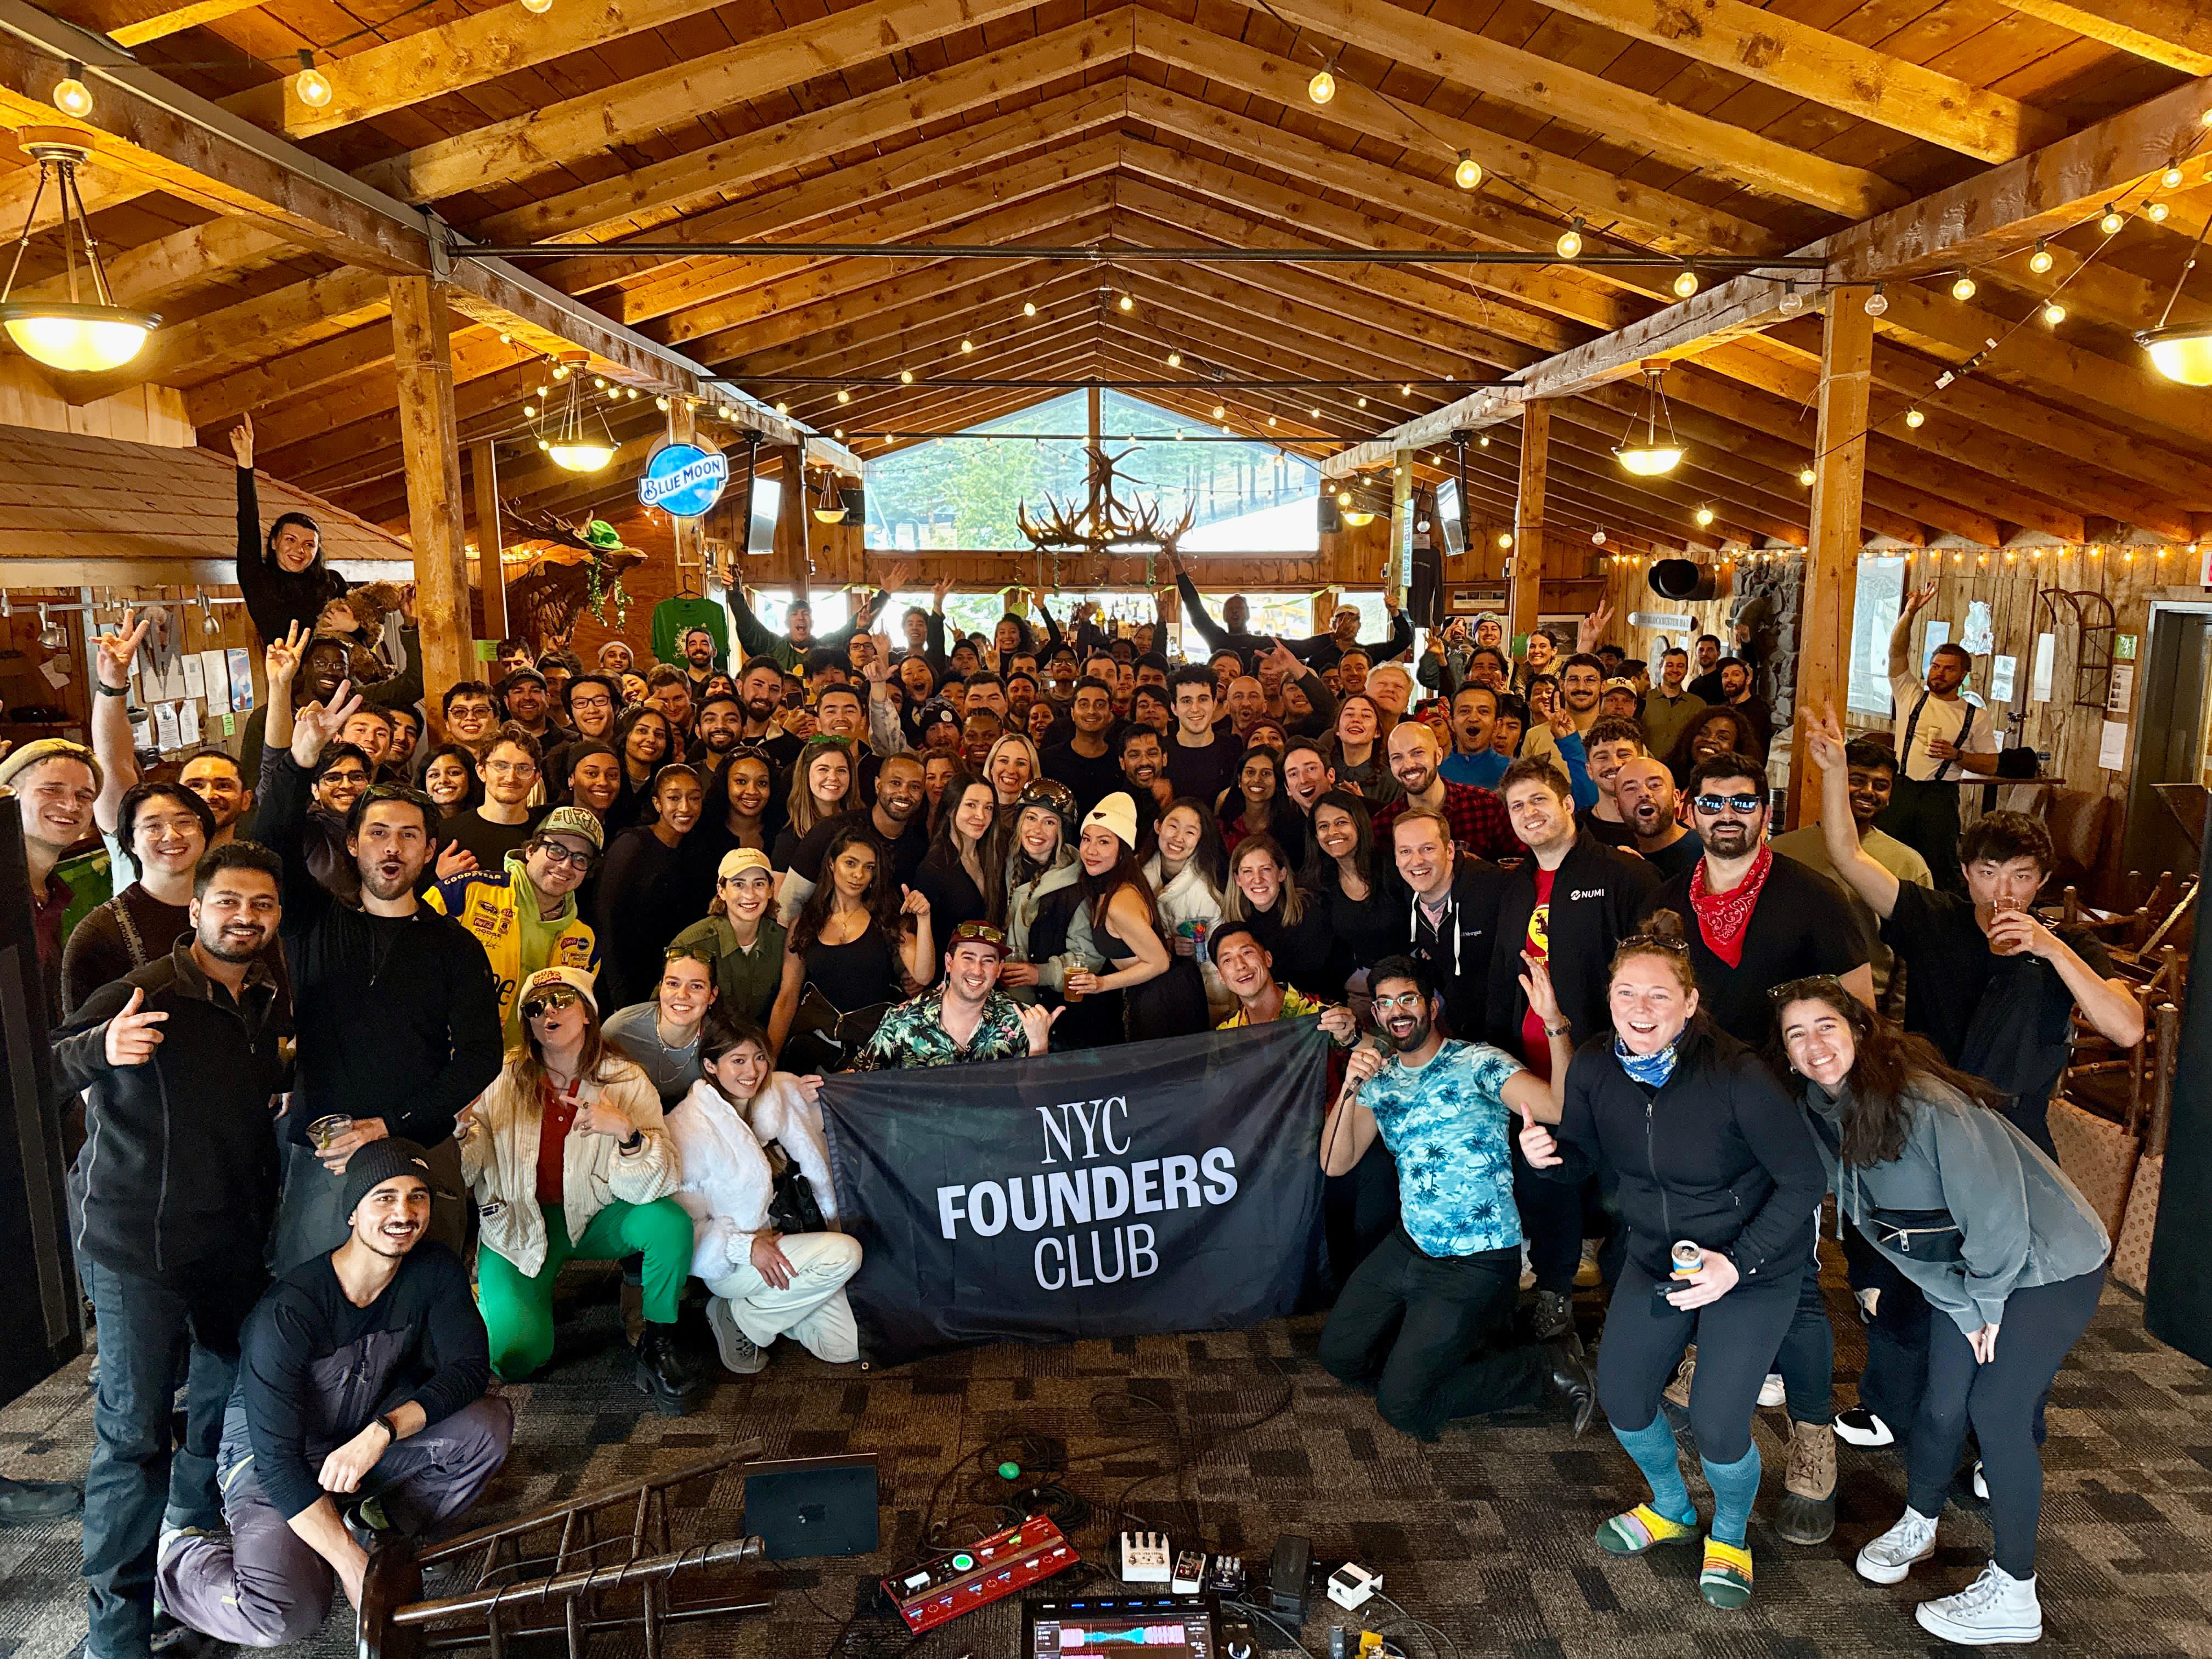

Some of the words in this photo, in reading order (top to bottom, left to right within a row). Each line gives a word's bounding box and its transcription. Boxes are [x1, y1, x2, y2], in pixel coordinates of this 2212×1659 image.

[644, 474, 681, 500] BLUE
[682, 459, 720, 484] MOON
[444, 871, 501, 885] GOODYEAR
[1581, 888, 1605, 899] NUMI
[1035, 1096, 1131, 1164] NYC
[936, 1146, 1238, 1240] FOUNDERS
[1034, 1223, 1159, 1290] CLUB
